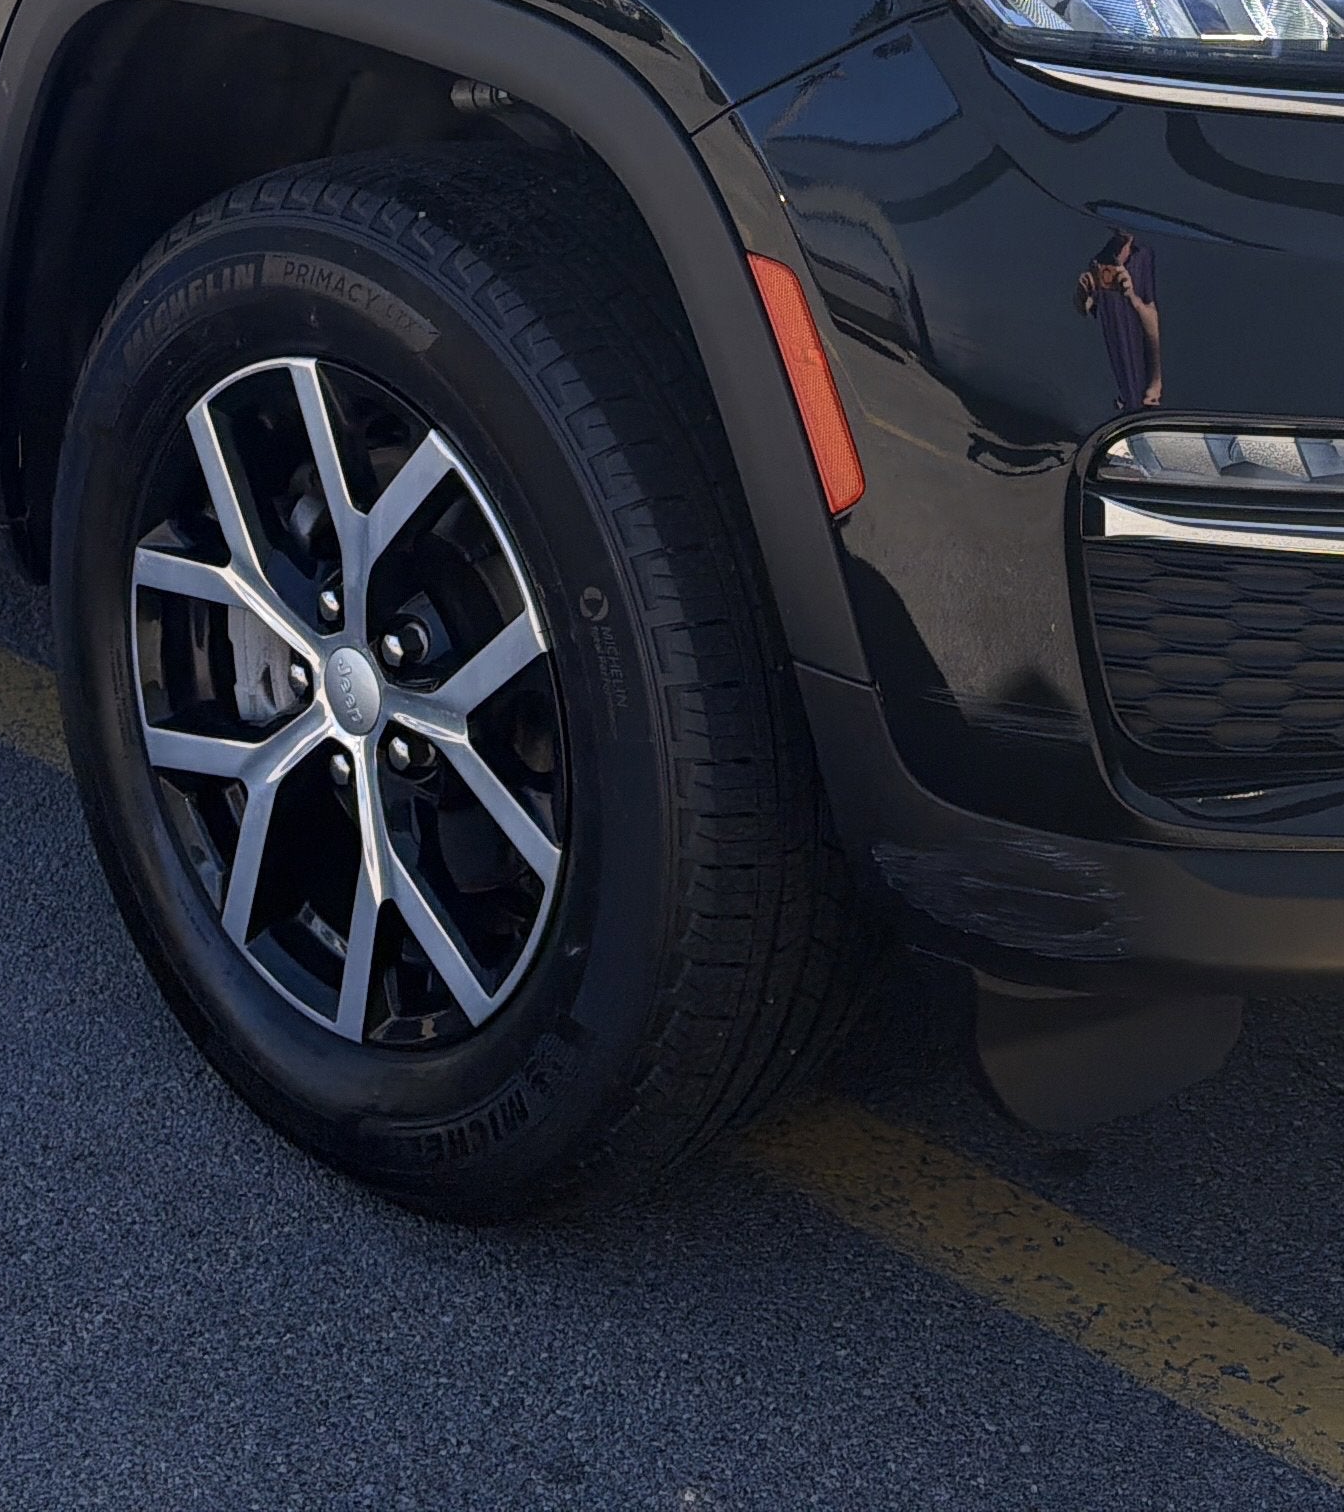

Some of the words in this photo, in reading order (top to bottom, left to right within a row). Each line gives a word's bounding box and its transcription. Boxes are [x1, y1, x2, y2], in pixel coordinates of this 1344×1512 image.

[122, 261, 256, 368] MICHELIN
[283, 259, 382, 311] PRIMACY
[331, 656, 364, 723] Jeep
[600, 626, 629, 709] MICHELIN
